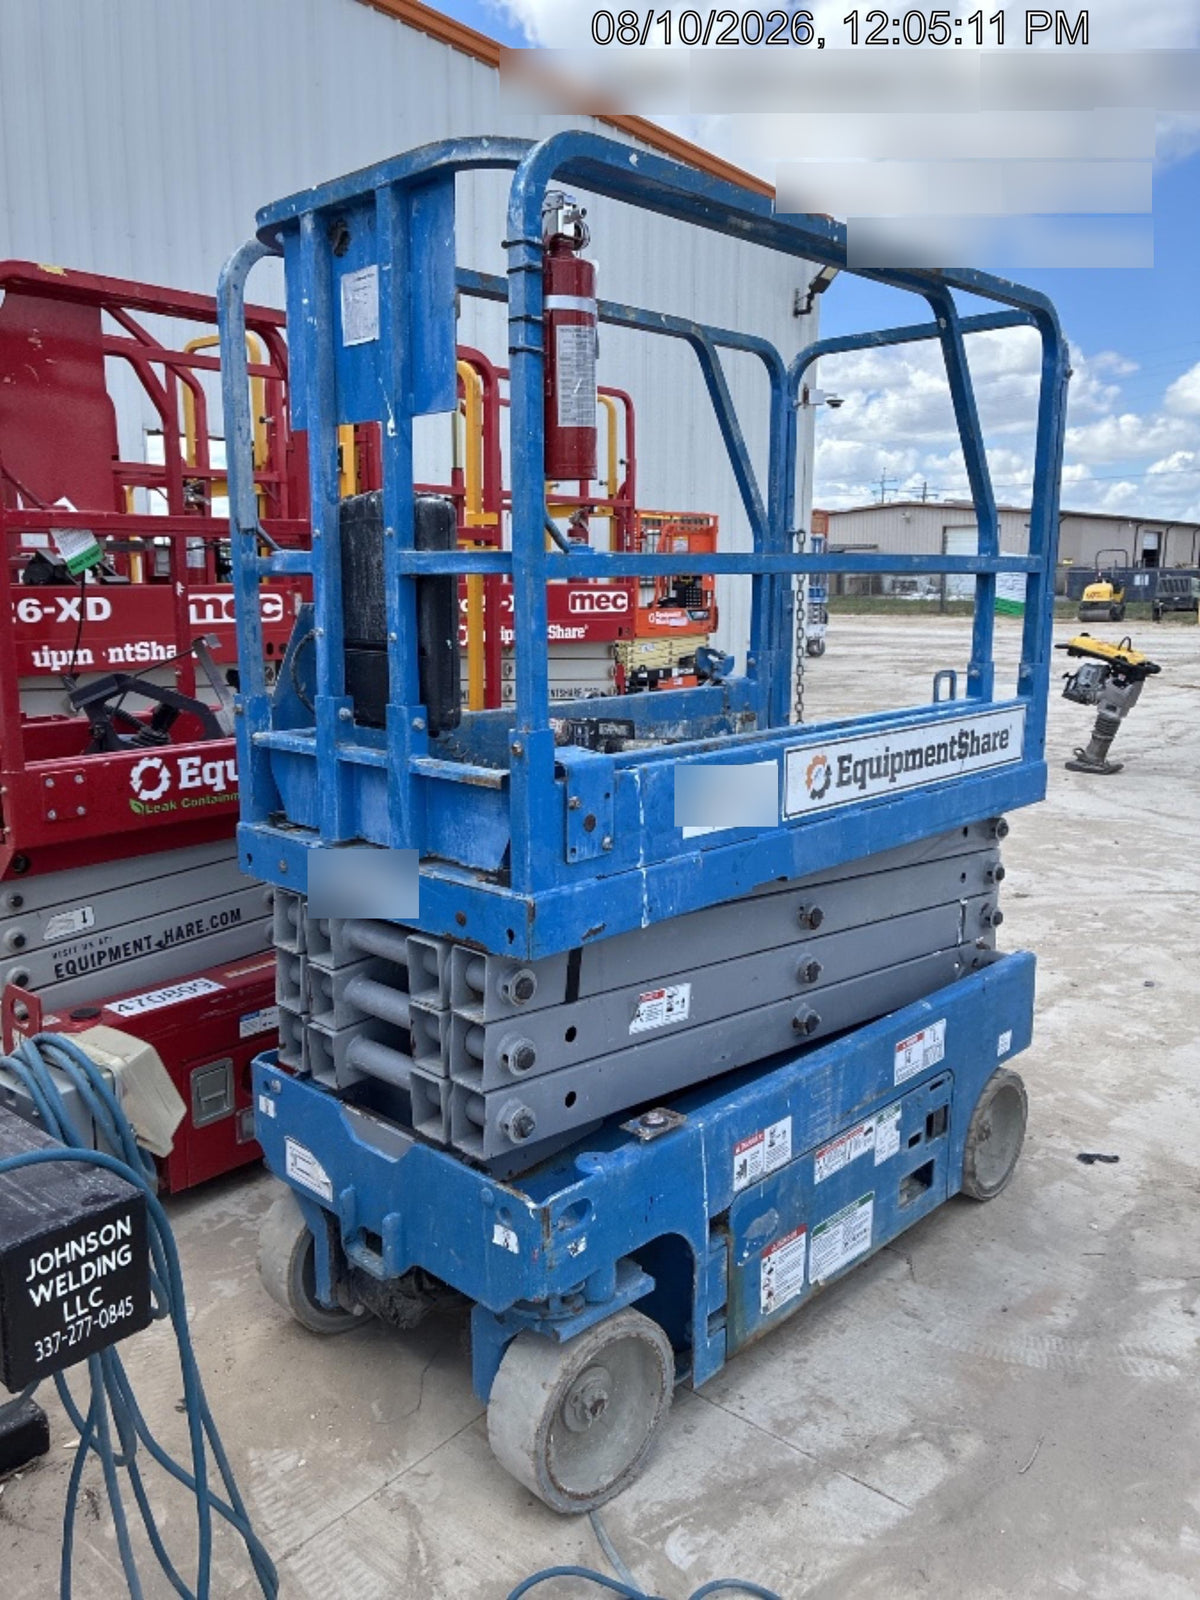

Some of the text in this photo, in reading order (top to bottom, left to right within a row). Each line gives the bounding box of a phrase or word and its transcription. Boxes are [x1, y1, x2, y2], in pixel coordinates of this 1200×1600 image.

[12, 596, 112, 624] 6-XD
[835, 728, 1010, 791] EquipmentShare
[54, 907, 242, 979] EQUIPMENTHARE.COM
[25, 1215, 132, 1283] JOHNSON
[29, 1244, 133, 1308] WELDING
[34, 1295, 134, 1363] 337-277-0845
[63, 1286, 104, 1324] LLC
